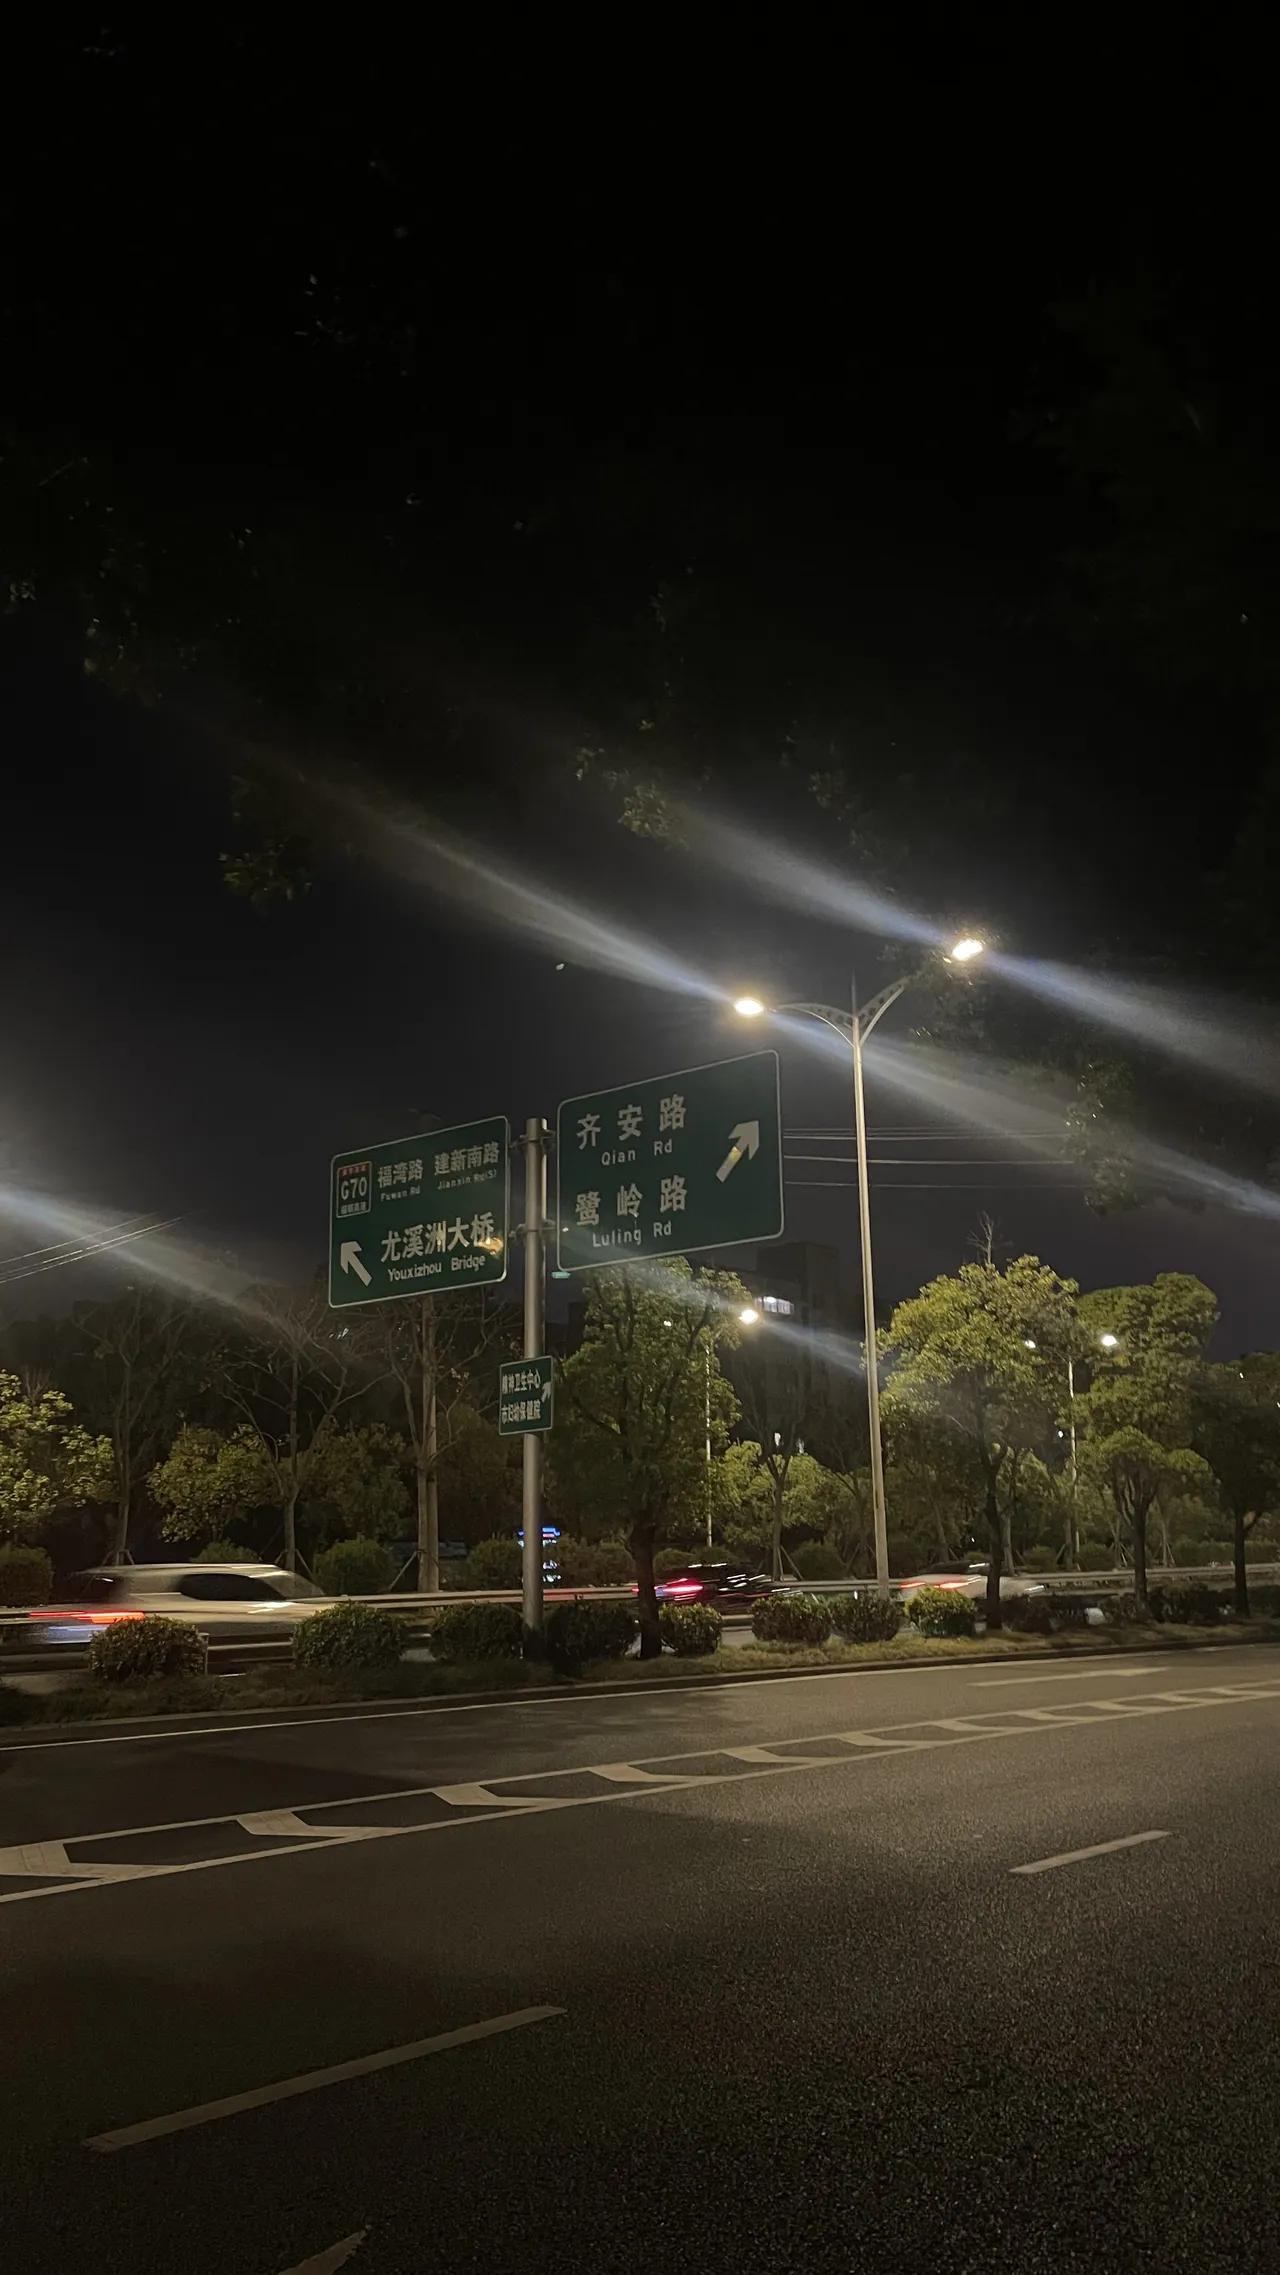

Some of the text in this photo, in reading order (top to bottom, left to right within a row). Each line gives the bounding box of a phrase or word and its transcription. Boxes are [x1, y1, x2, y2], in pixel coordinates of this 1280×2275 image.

[576, 1093, 687, 1150] 齐安路
[378, 1141, 499, 1188] 福湾路 建新南路
[601, 1138, 673, 1166] Qian Rd
[341, 1176, 367, 1200] G70
[575, 1174, 688, 1227] 鹭岭路
[380, 1211, 496, 1264] 尤溪洲大桥
[592, 1220, 673, 1248] Luling Rd
[387, 1254, 486, 1282] Youxizhou Bridge
